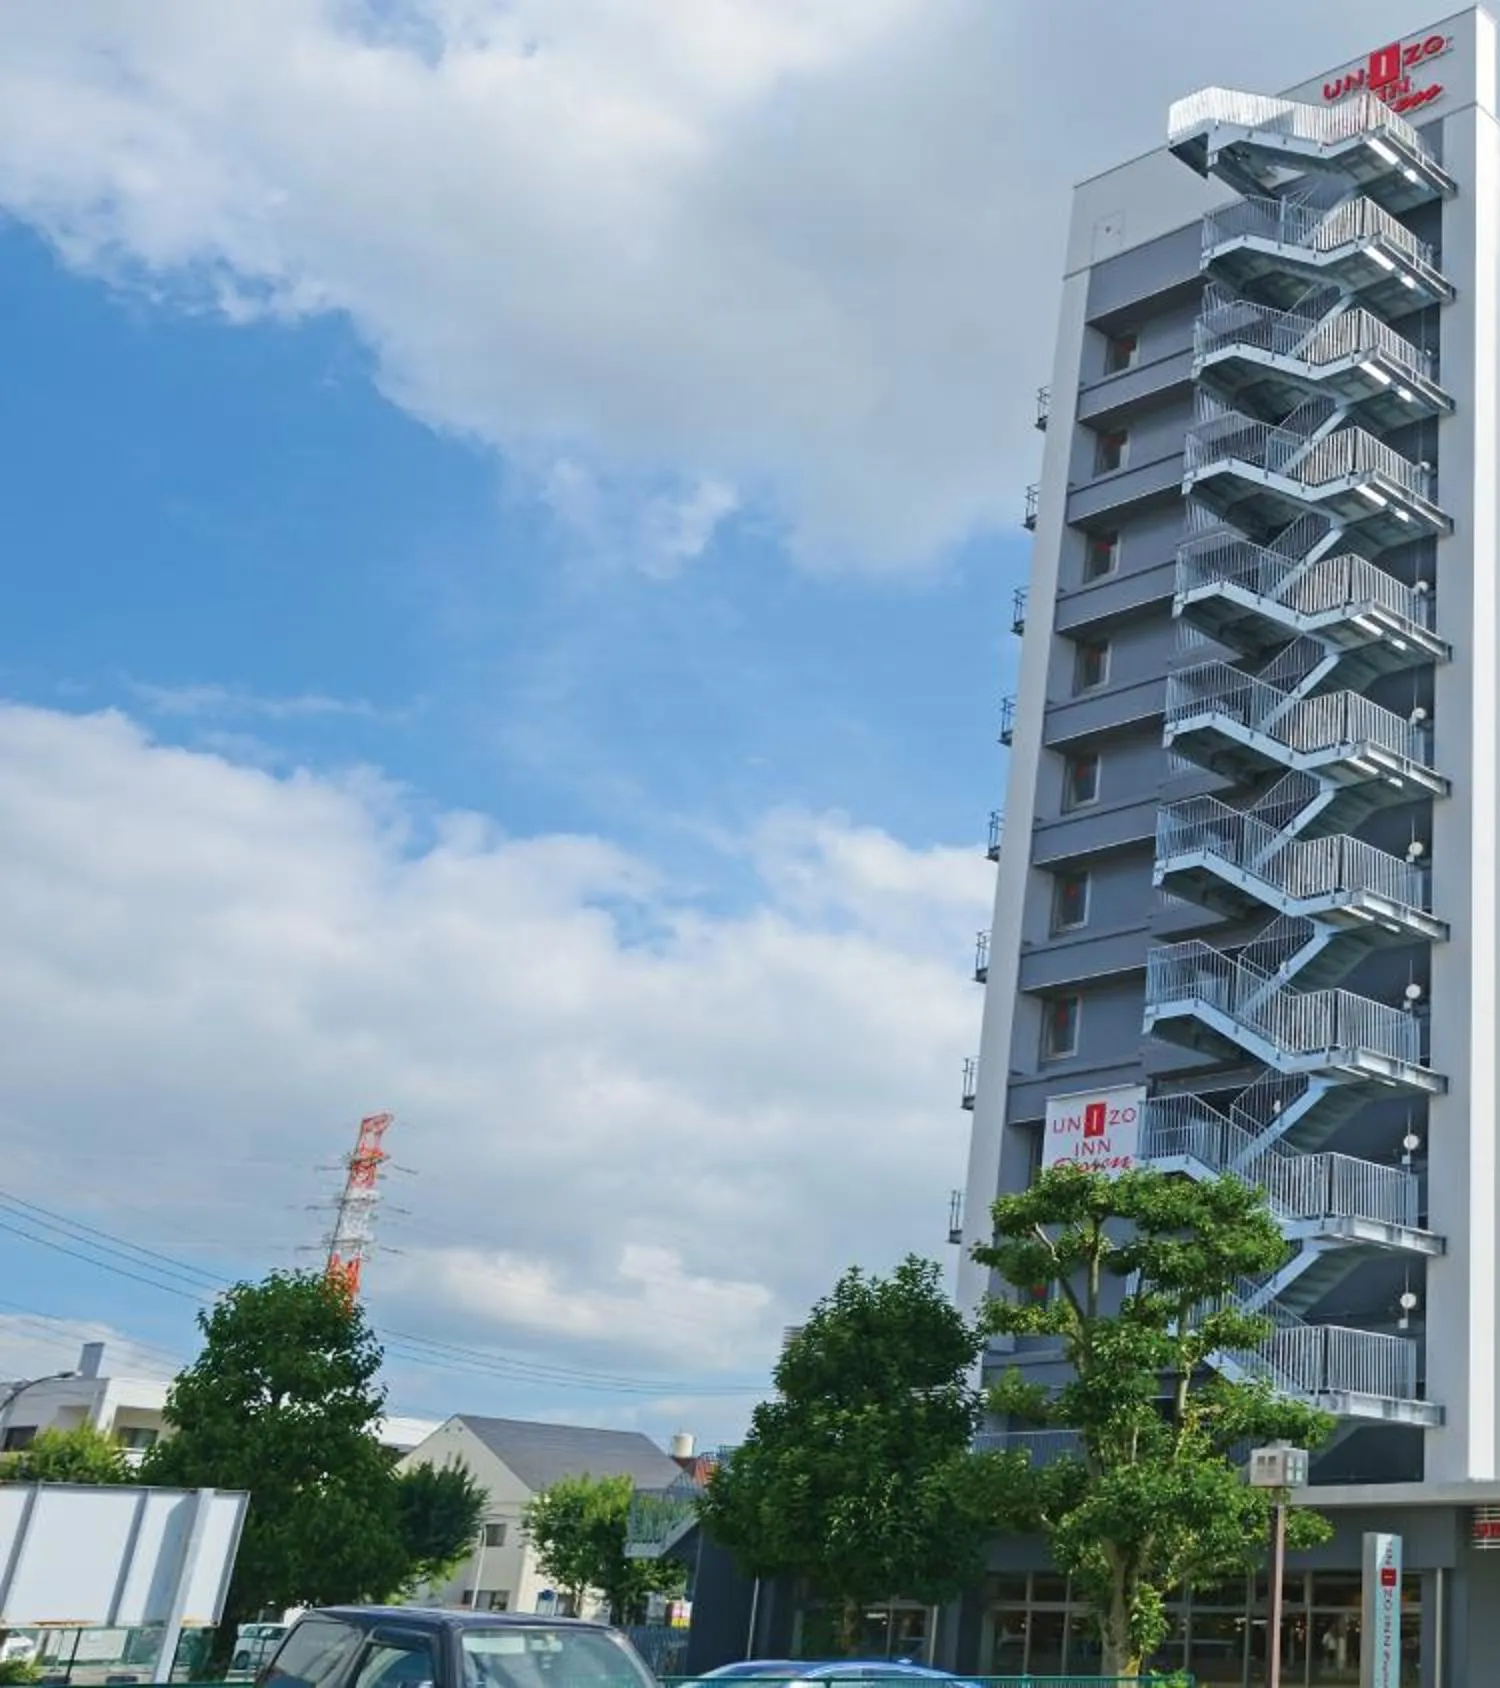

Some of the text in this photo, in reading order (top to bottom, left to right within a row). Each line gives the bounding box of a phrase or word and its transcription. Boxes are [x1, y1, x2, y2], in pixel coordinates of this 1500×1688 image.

[1323, 35, 1446, 100] UNIZO
[1053, 1103, 1137, 1138] UNIZO
[1074, 1138, 1112, 1157] INN
